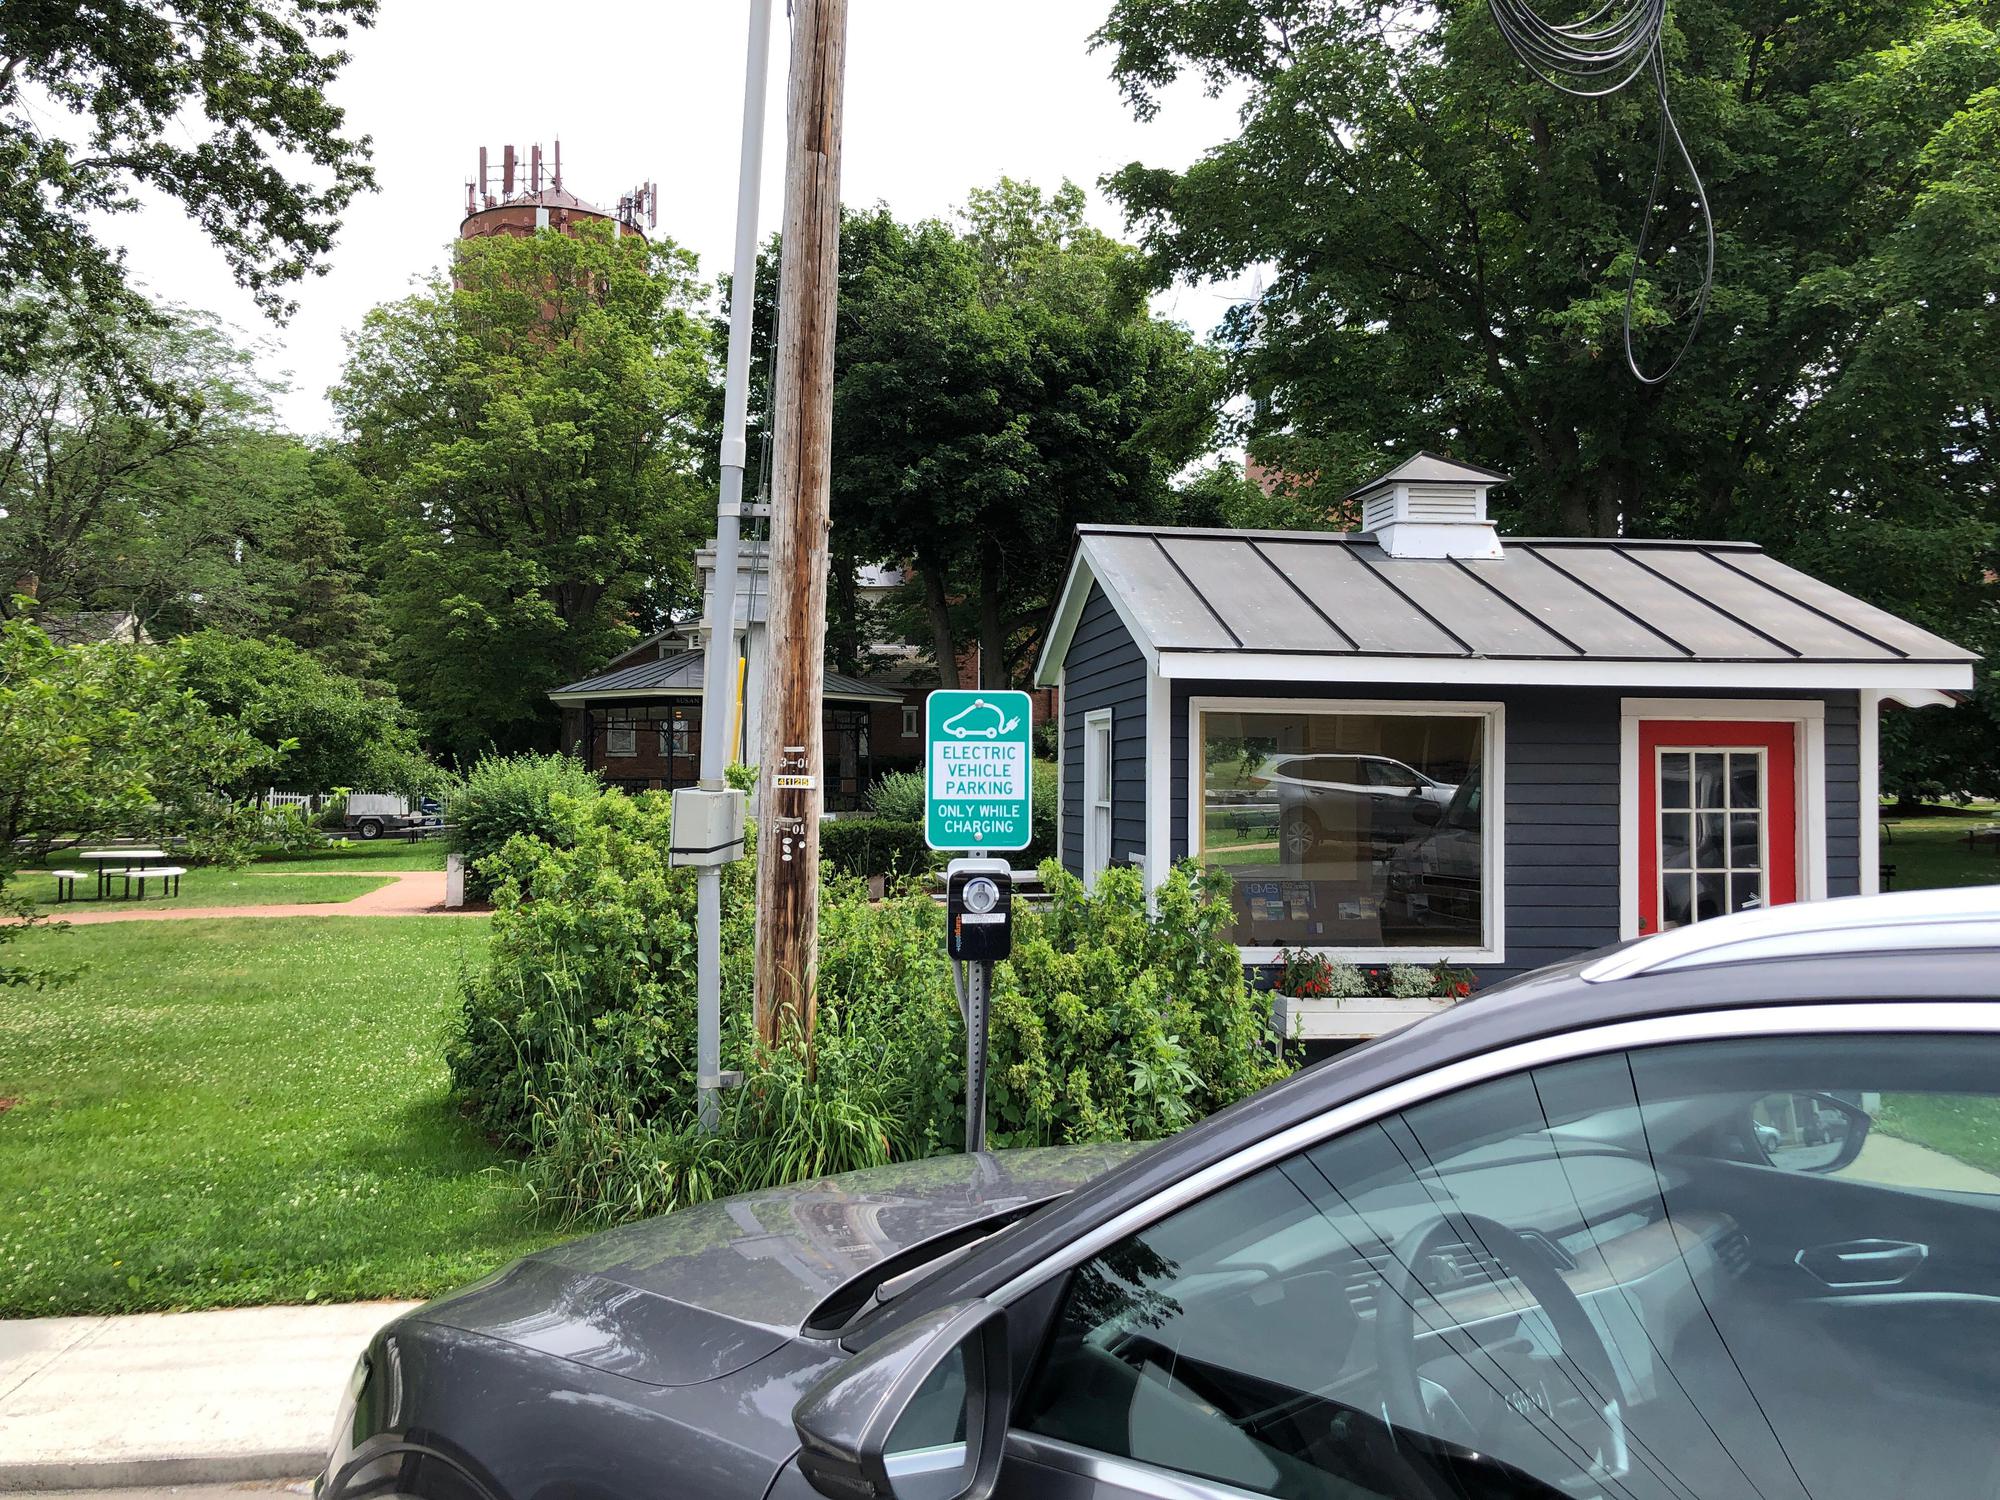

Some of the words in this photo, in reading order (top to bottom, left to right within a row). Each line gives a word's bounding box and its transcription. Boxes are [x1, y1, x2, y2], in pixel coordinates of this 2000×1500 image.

[943, 746, 1016, 760] ELECTRIC
[947, 763, 1012, 777] VEHICLE
[945, 781, 1014, 795] PARKING
[937, 804, 975, 818] ONLY
[979, 804, 1020, 818] WHILE
[944, 820, 1014, 833] CHARGING
